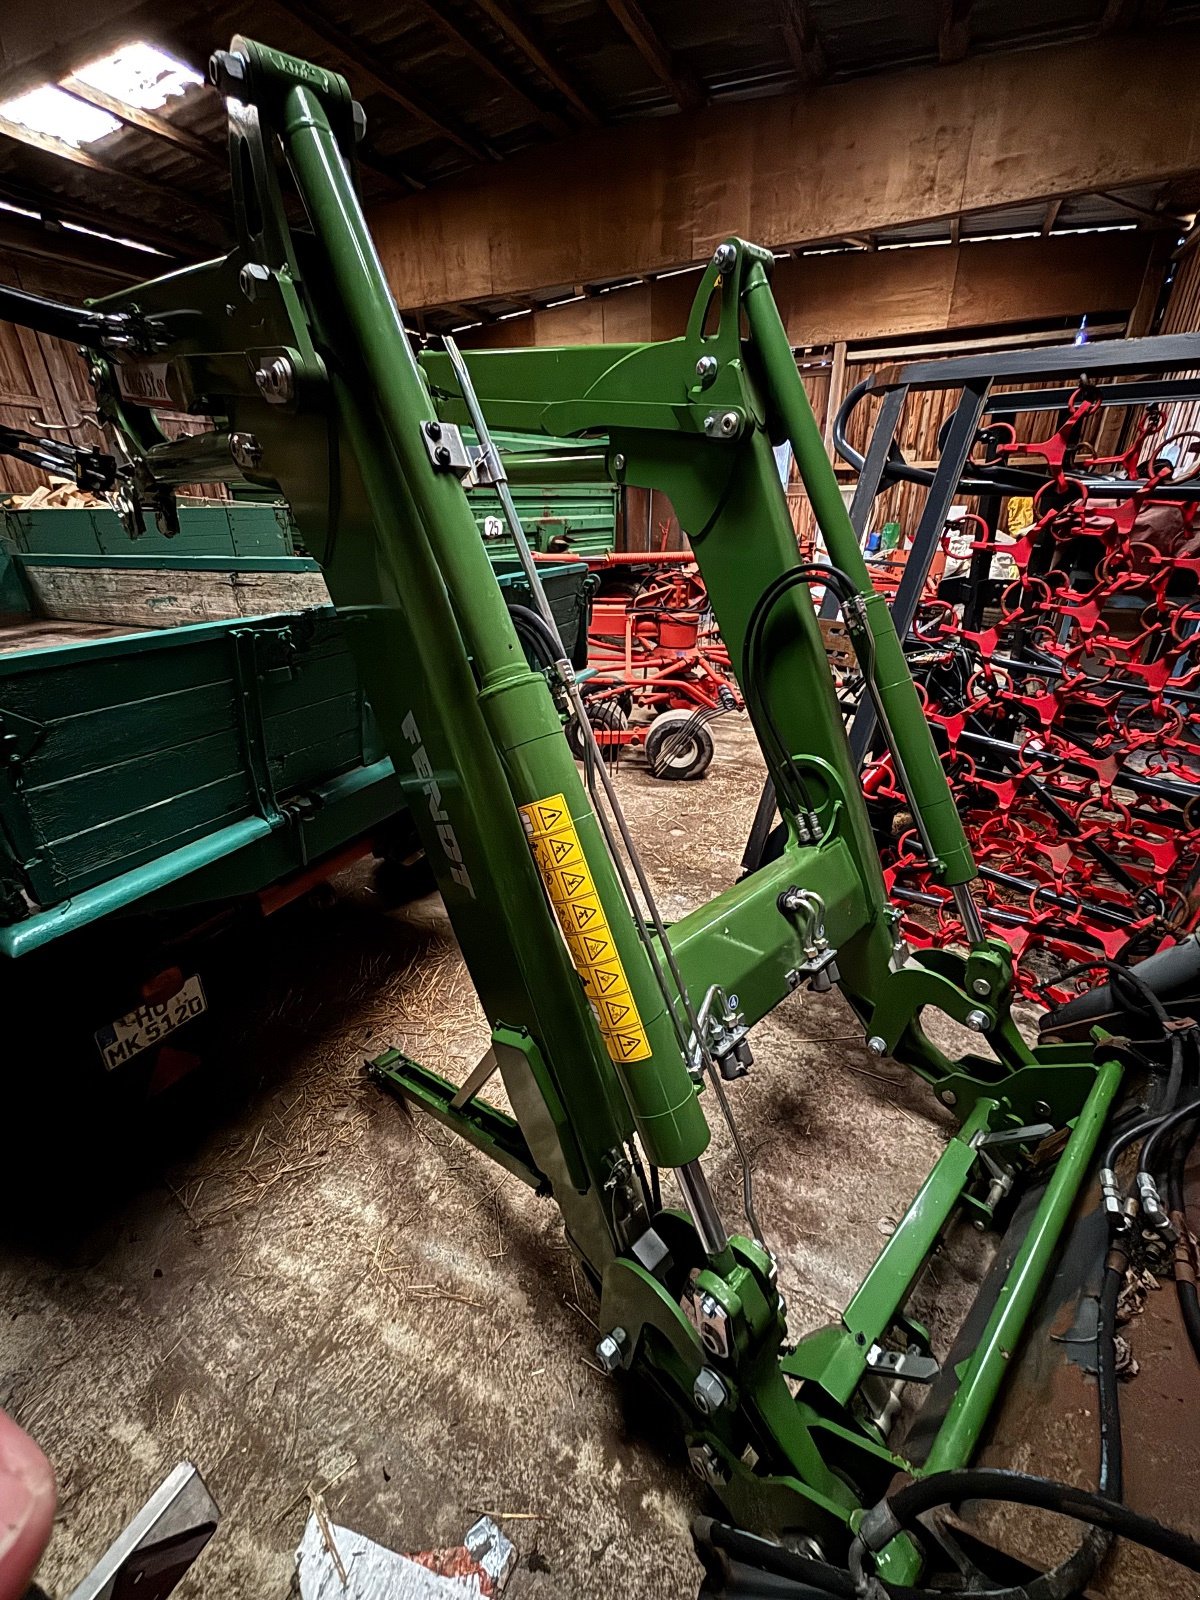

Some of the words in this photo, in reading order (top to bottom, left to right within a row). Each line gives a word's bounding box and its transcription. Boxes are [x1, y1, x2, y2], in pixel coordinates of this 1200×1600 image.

[488, 520, 499, 536] 25
[401, 710, 476, 900] FENDT
[107, 1032, 146, 1067] MK
[145, 995, 204, 1042] 5120
